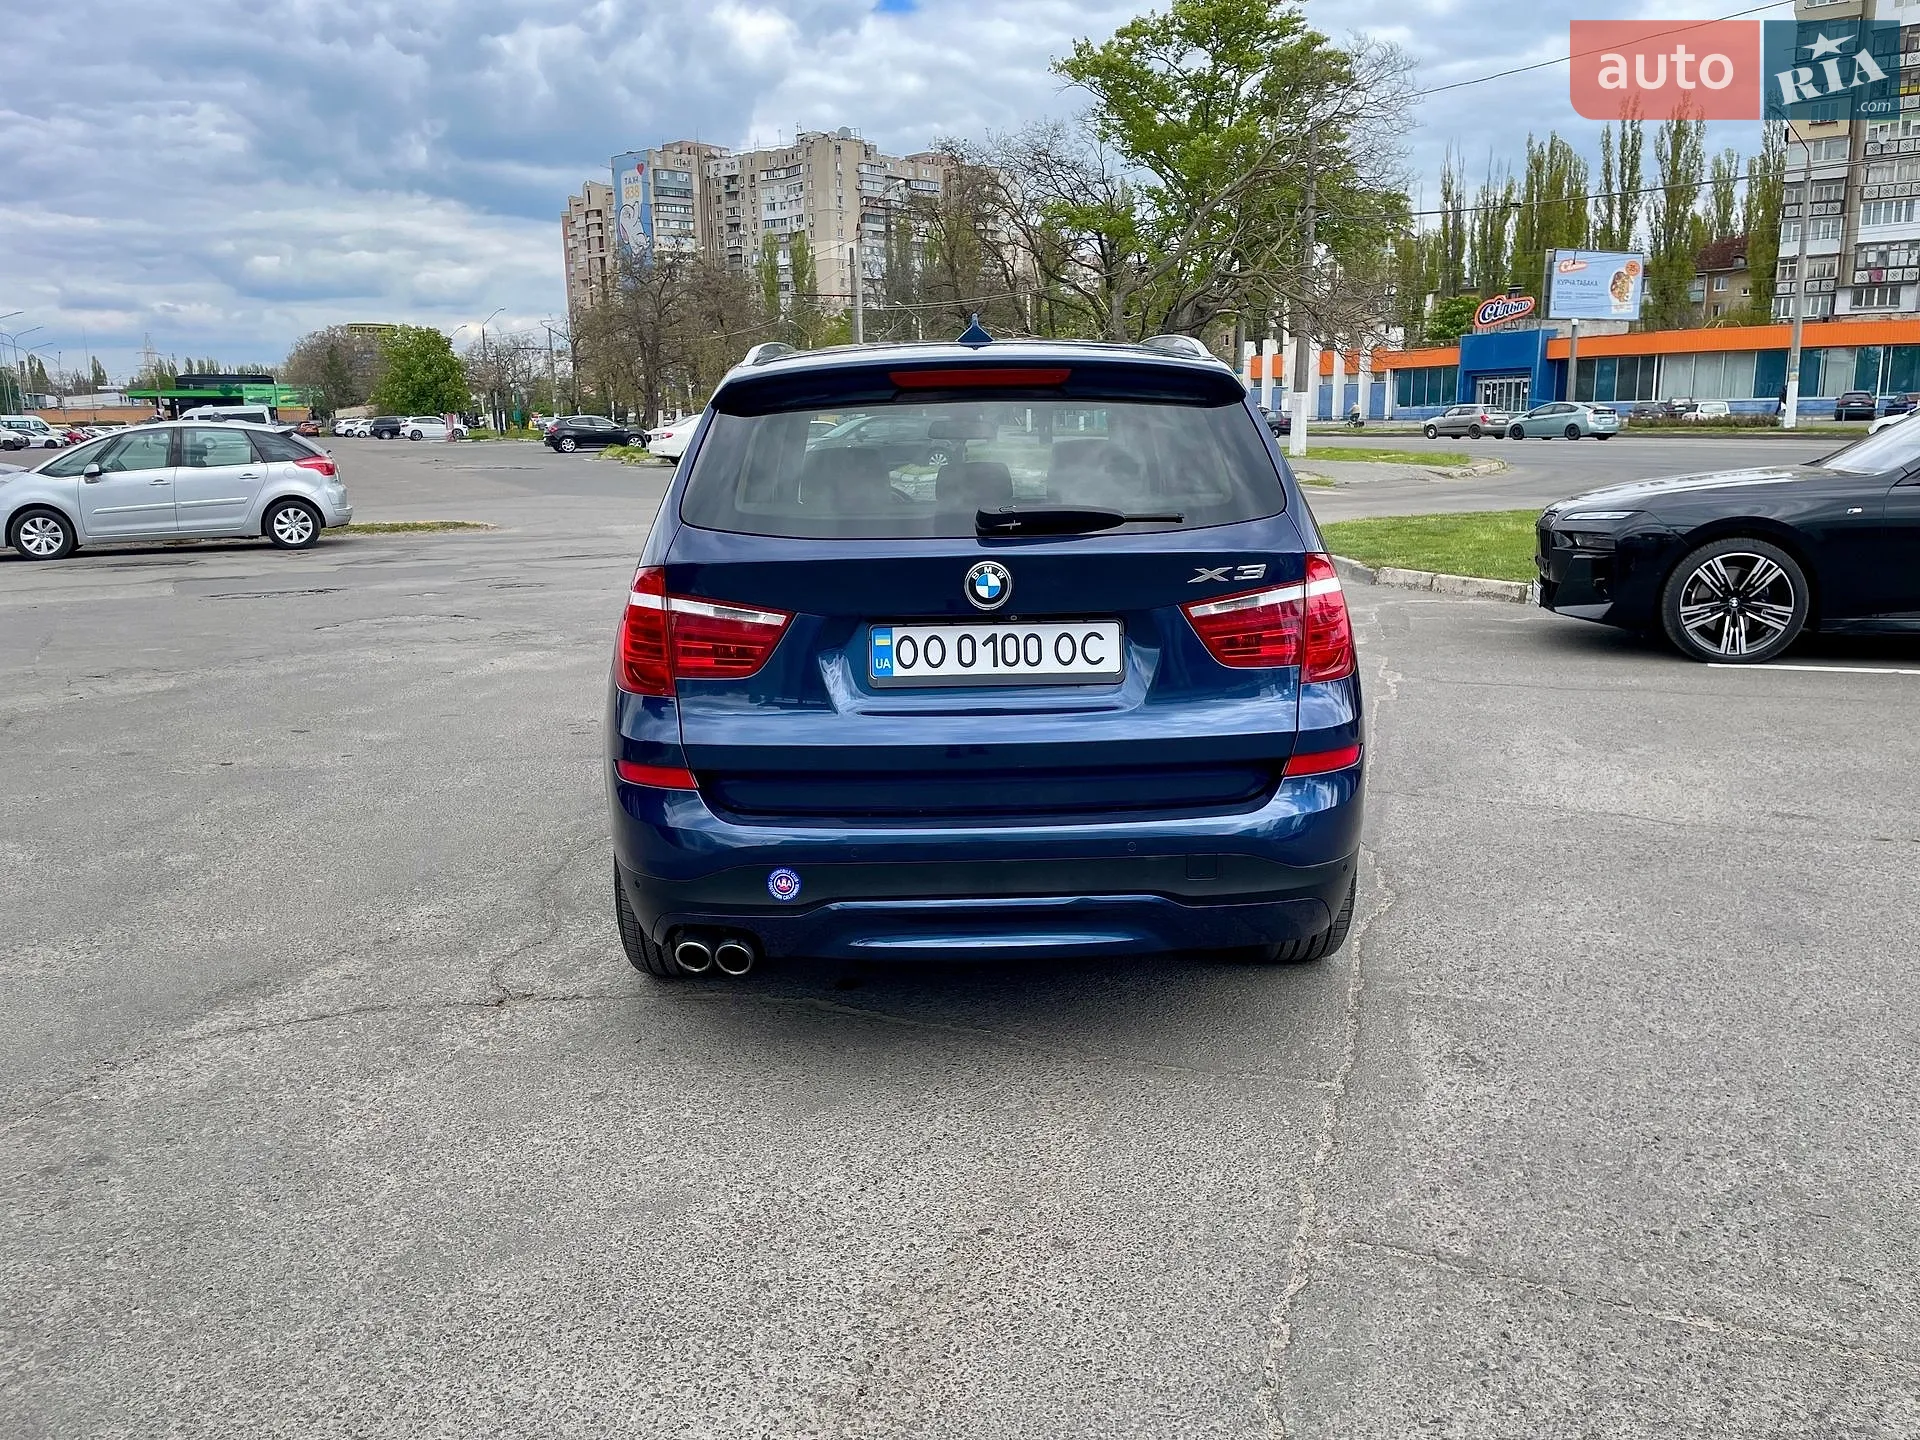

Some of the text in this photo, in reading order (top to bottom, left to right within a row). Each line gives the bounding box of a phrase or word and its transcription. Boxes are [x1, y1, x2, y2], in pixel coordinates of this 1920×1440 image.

[1480, 300, 1530, 323] Сільпо
[971, 566, 1006, 580] BMW
[1187, 563, 1267, 584] X3
[957, 633, 1042, 668] 0100
[875, 658, 891, 669] UA
